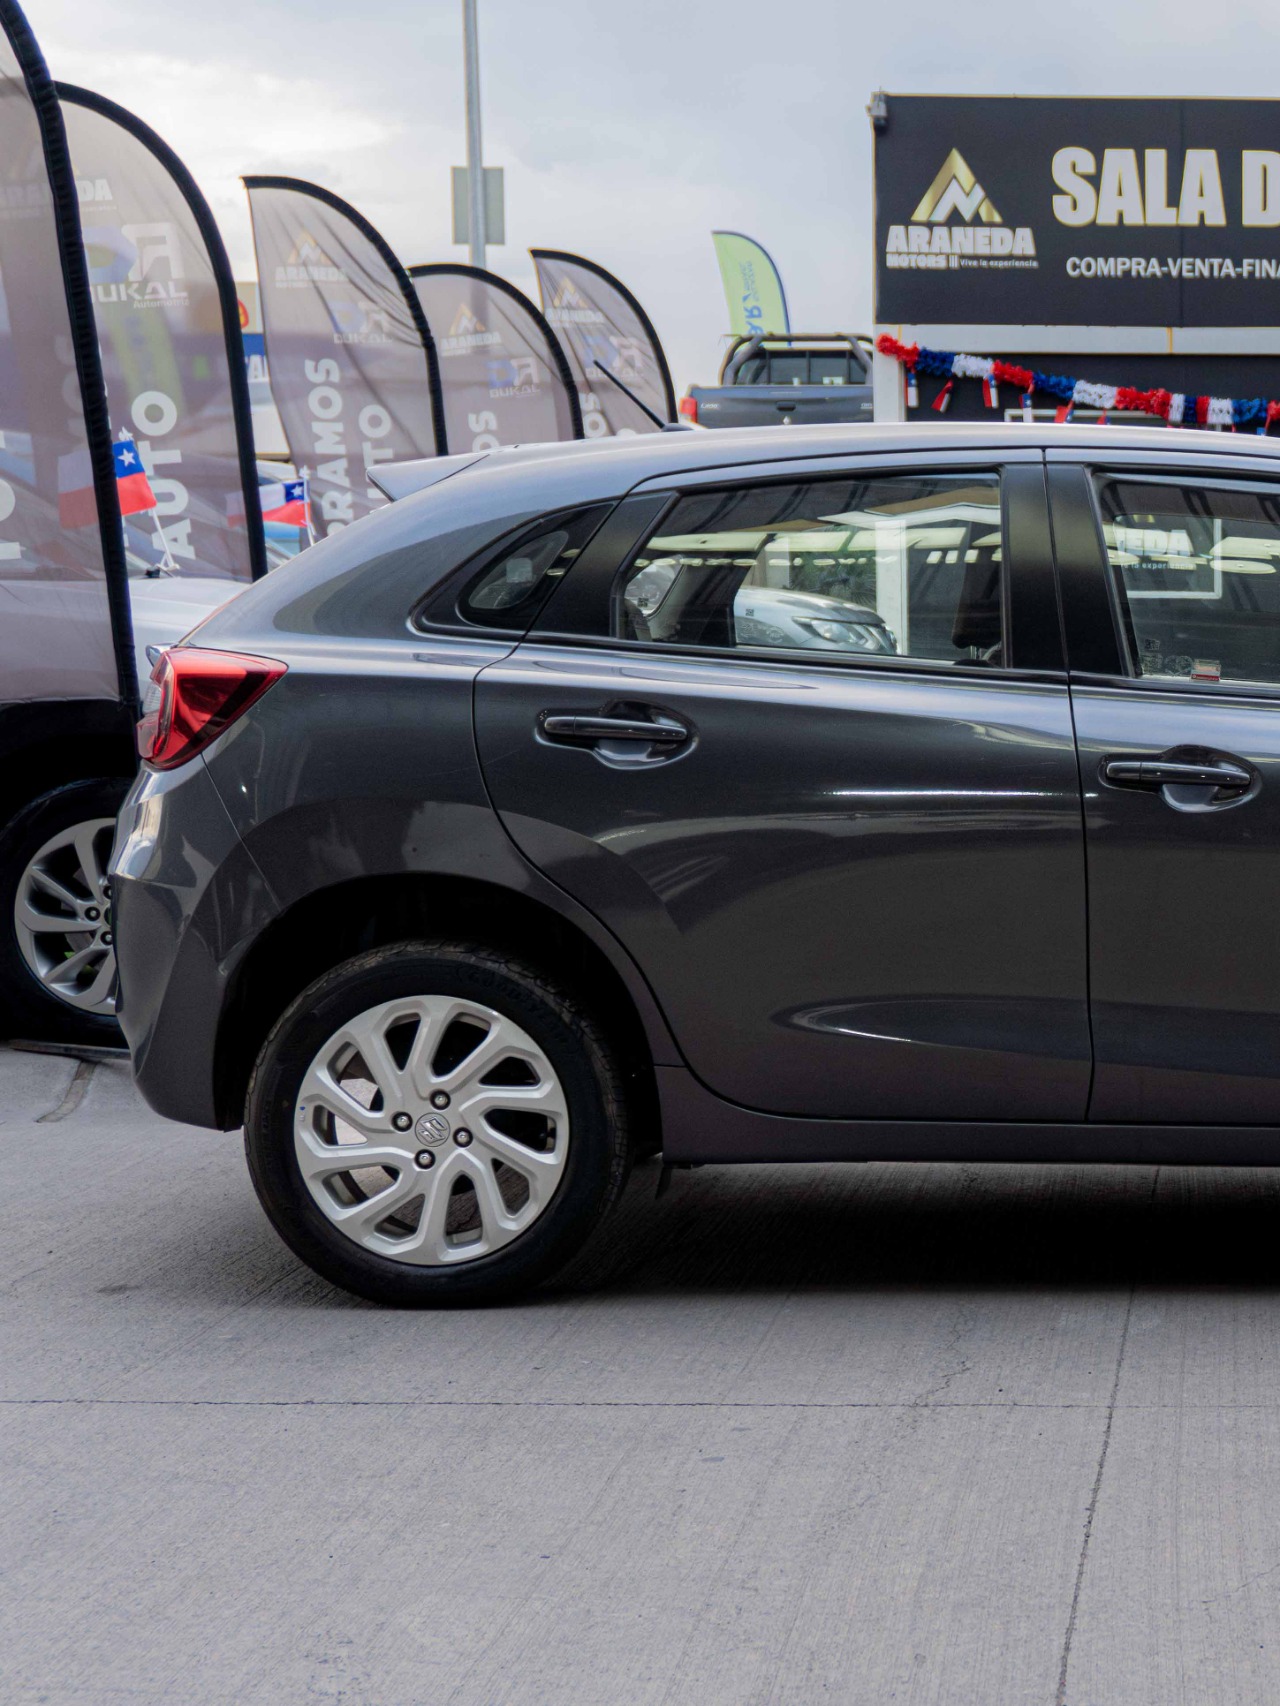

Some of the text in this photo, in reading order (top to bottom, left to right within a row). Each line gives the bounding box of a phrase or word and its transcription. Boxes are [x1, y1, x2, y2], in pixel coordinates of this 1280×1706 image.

[1051, 147, 1226, 228] SALA
[886, 225, 1036, 256] ARANEDA
[886, 254, 946, 269] MOTORS
[960, 258, 976, 267] Vive
[989, 259, 1038, 268] experiencia
[490, 385, 541, 398] DUKAL
